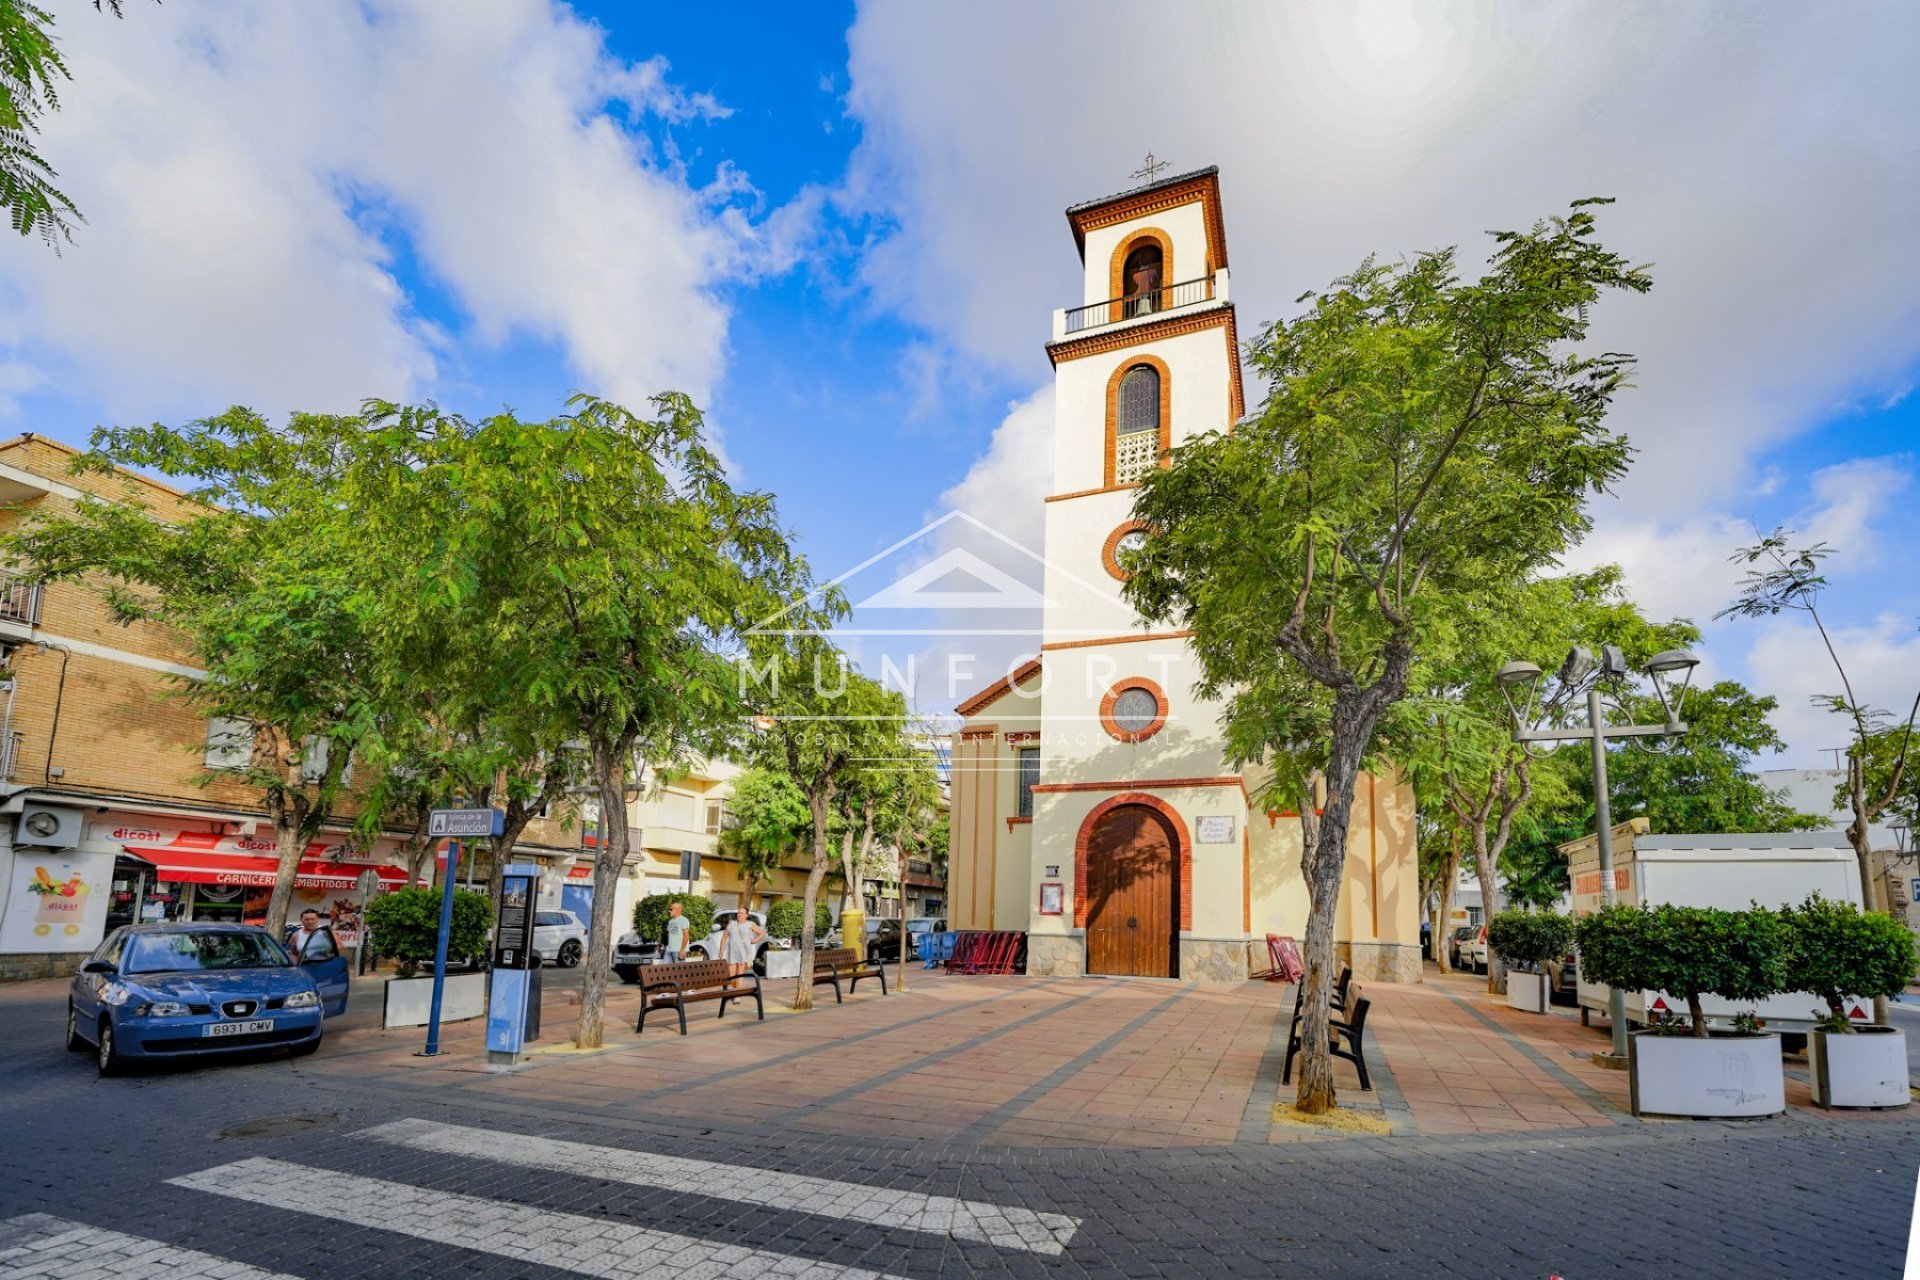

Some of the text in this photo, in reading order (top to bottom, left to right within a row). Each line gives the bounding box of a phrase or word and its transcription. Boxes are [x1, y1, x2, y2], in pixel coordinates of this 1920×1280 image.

[467, 812, 476, 820] de
[447, 821, 488, 833] Asunción
[112, 828, 161, 841] dicost
[237, 839, 277, 851] dicost
[216, 873, 276, 886] CARNICERI
[213, 1021, 271, 1035] 6931 CMV
